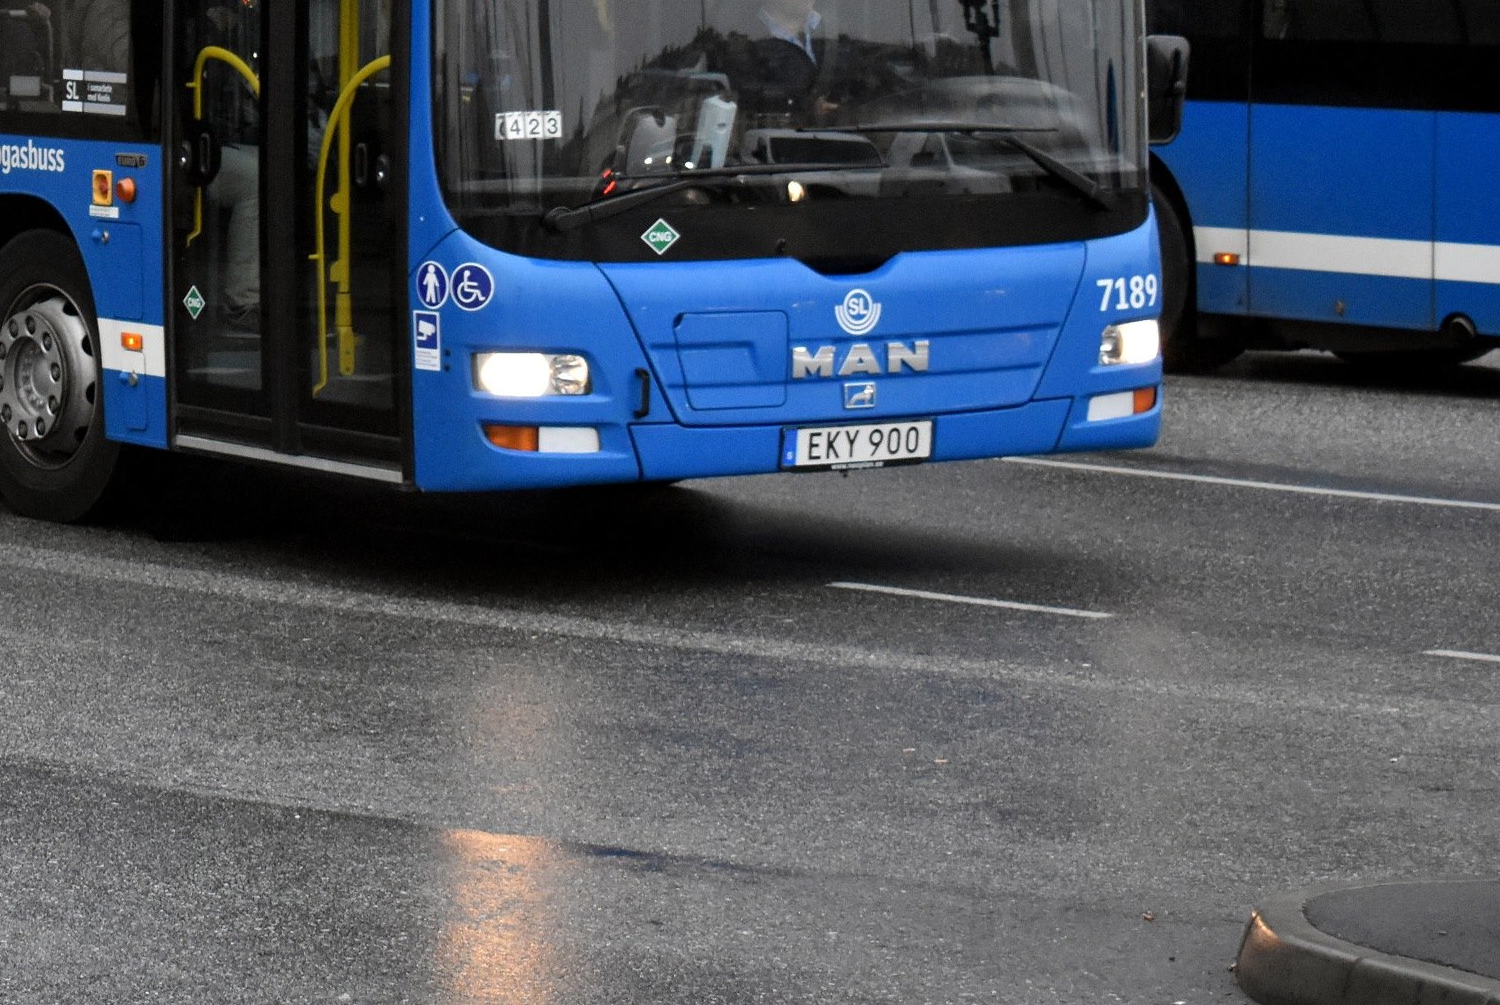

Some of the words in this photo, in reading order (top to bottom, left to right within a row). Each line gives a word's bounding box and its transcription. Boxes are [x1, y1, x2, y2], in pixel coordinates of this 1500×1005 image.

[66, 81, 80, 100] SL
[649, 231, 672, 242] CNG
[1096, 274, 1158, 311] 7189
[187, 297, 201, 308] CNG
[848, 297, 868, 316] SL
[792, 340, 930, 379] MAN
[808, 429, 859, 460] EKY
[869, 426, 919, 456] 900
